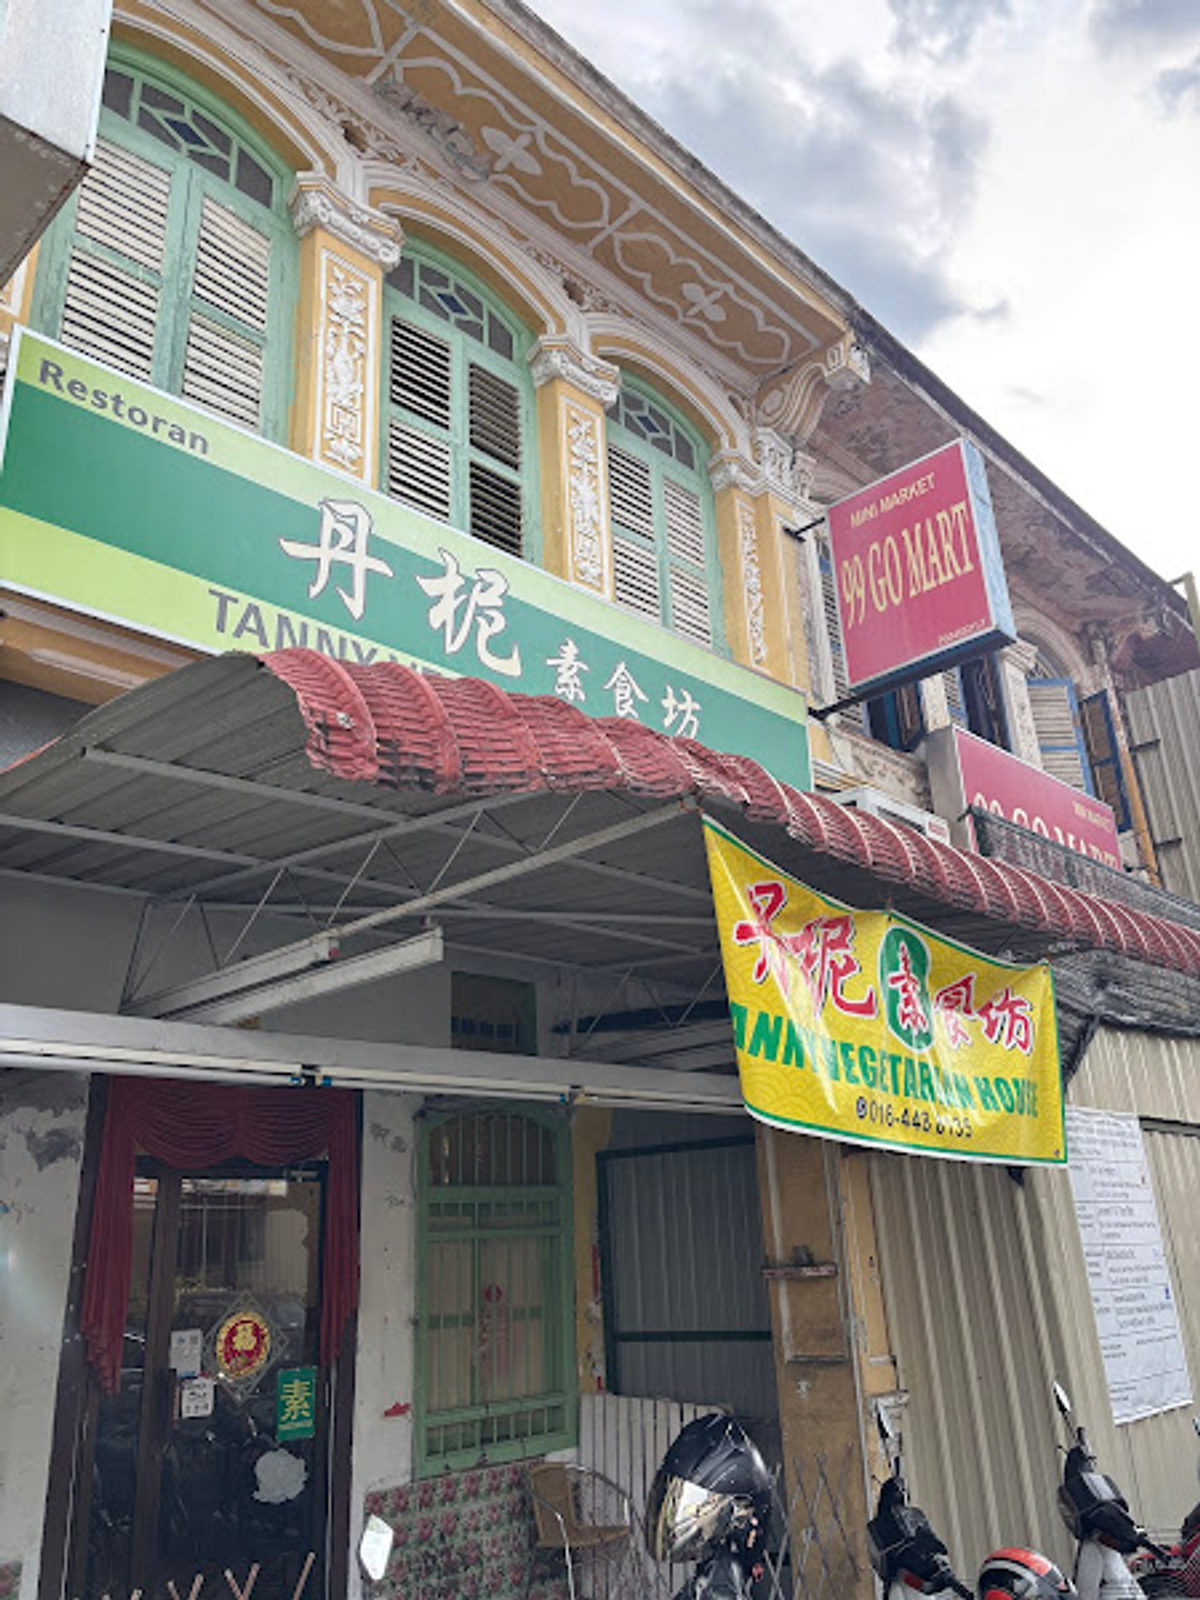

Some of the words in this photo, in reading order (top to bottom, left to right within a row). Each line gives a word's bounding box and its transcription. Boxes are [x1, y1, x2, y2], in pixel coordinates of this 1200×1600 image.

[40, 359, 210, 456] Restoran
[880, 471, 935, 512] MARKET
[841, 554, 866, 629] 99
[868, 534, 902, 613] GO
[902, 500, 974, 598] MART
[280, 1380, 311, 1420] 素
